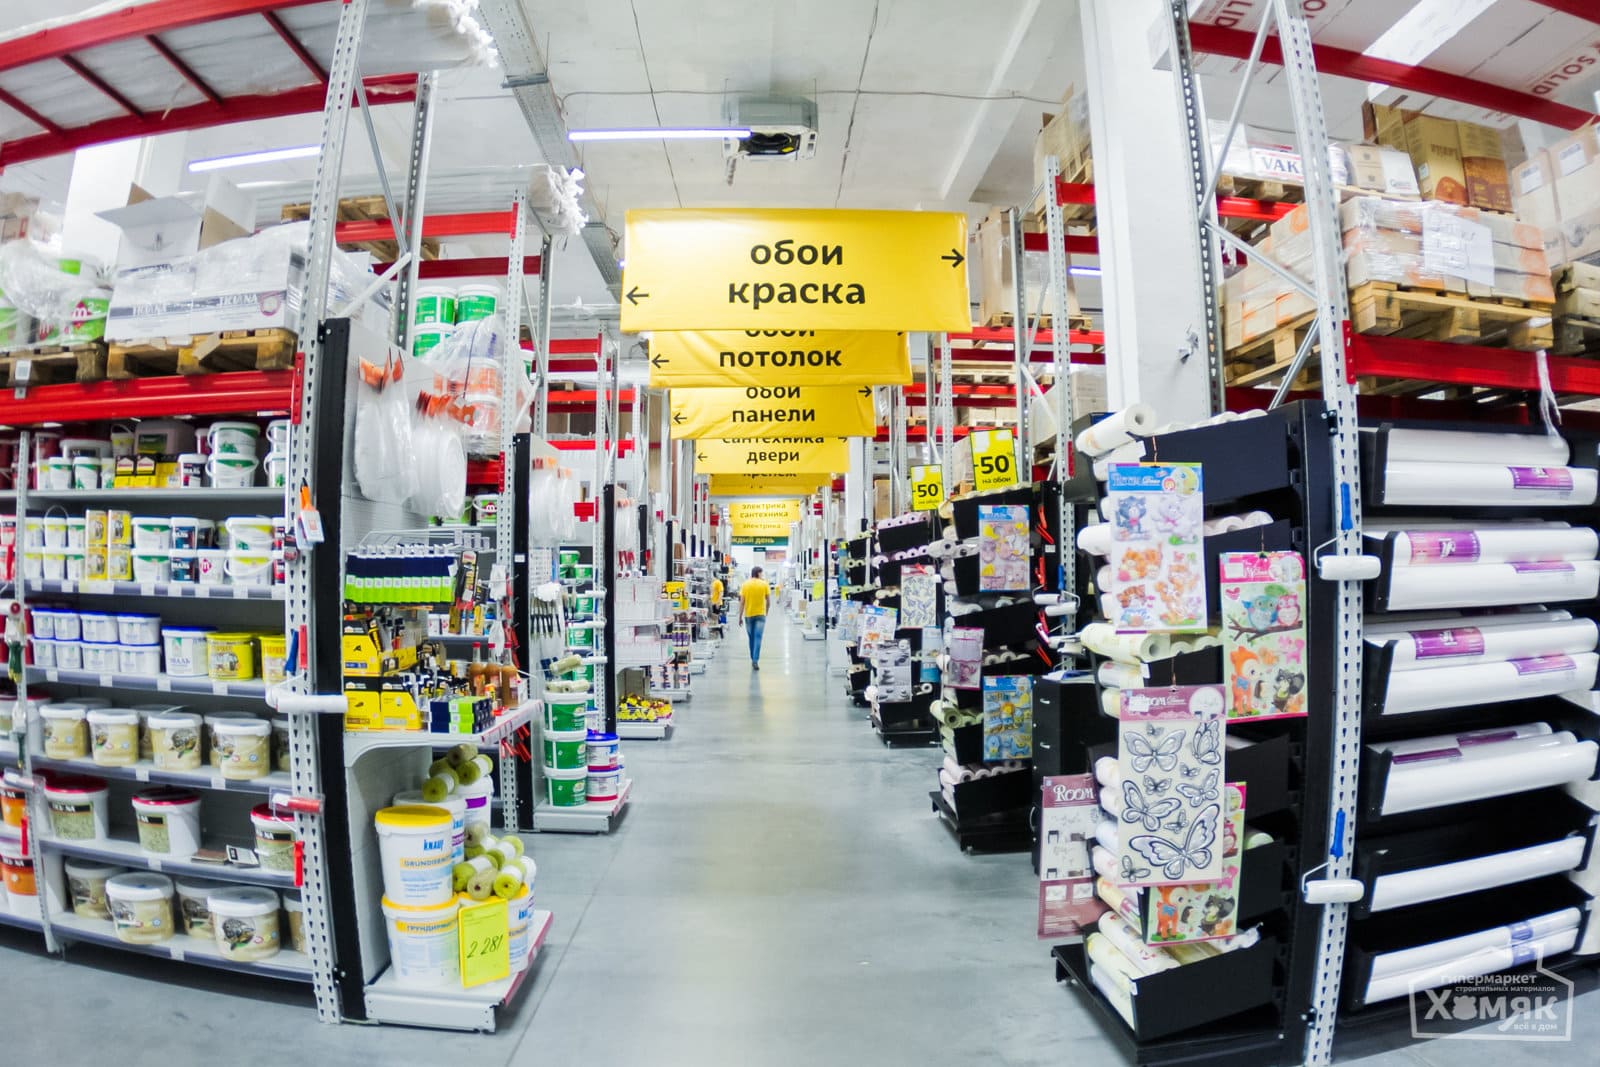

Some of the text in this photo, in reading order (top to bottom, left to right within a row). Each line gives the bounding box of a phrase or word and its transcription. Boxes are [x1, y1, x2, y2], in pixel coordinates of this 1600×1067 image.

[750, 239, 844, 266] обои
[728, 282, 866, 310] краска
[719, 349, 843, 368] потолок
[732, 408, 816, 424] панели
[746, 451, 800, 464] двери
[993, 476, 1012, 484] обои
[740, 511, 789, 519] сантехника
